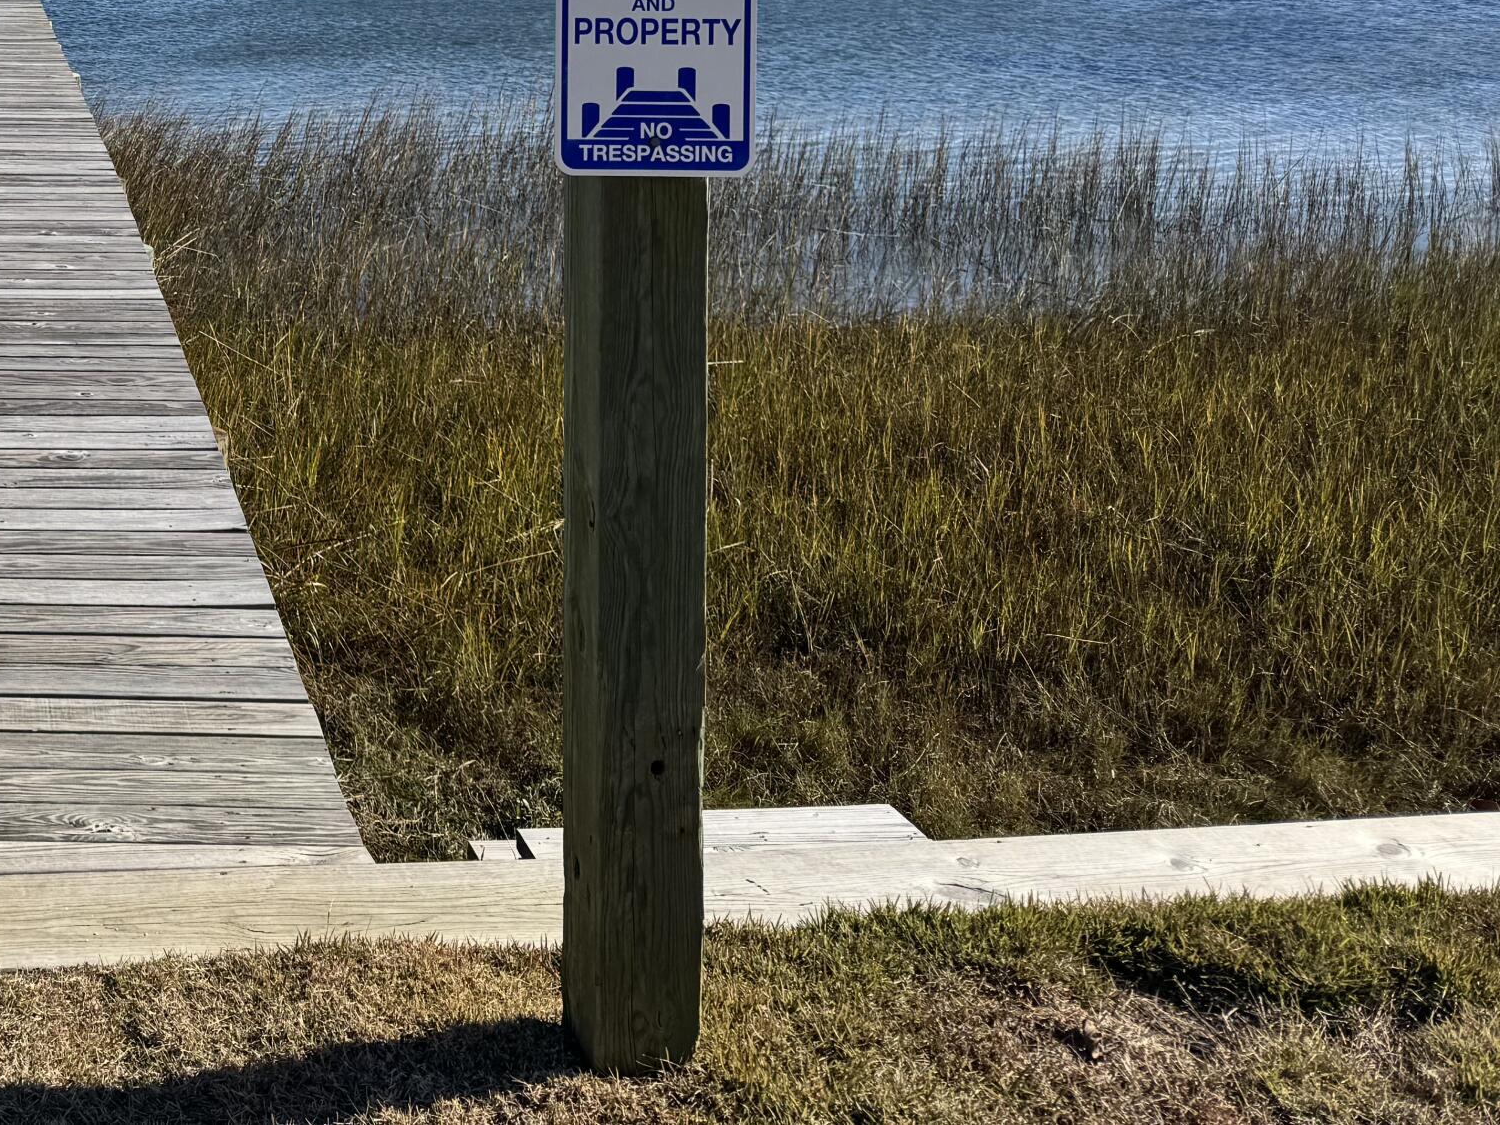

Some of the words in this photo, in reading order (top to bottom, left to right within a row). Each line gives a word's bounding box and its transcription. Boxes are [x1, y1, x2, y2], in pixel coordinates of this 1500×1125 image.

[574, 17, 741, 46] PROPERTY
[640, 122, 673, 139] NO
[579, 144, 733, 163] TRESPASSING
